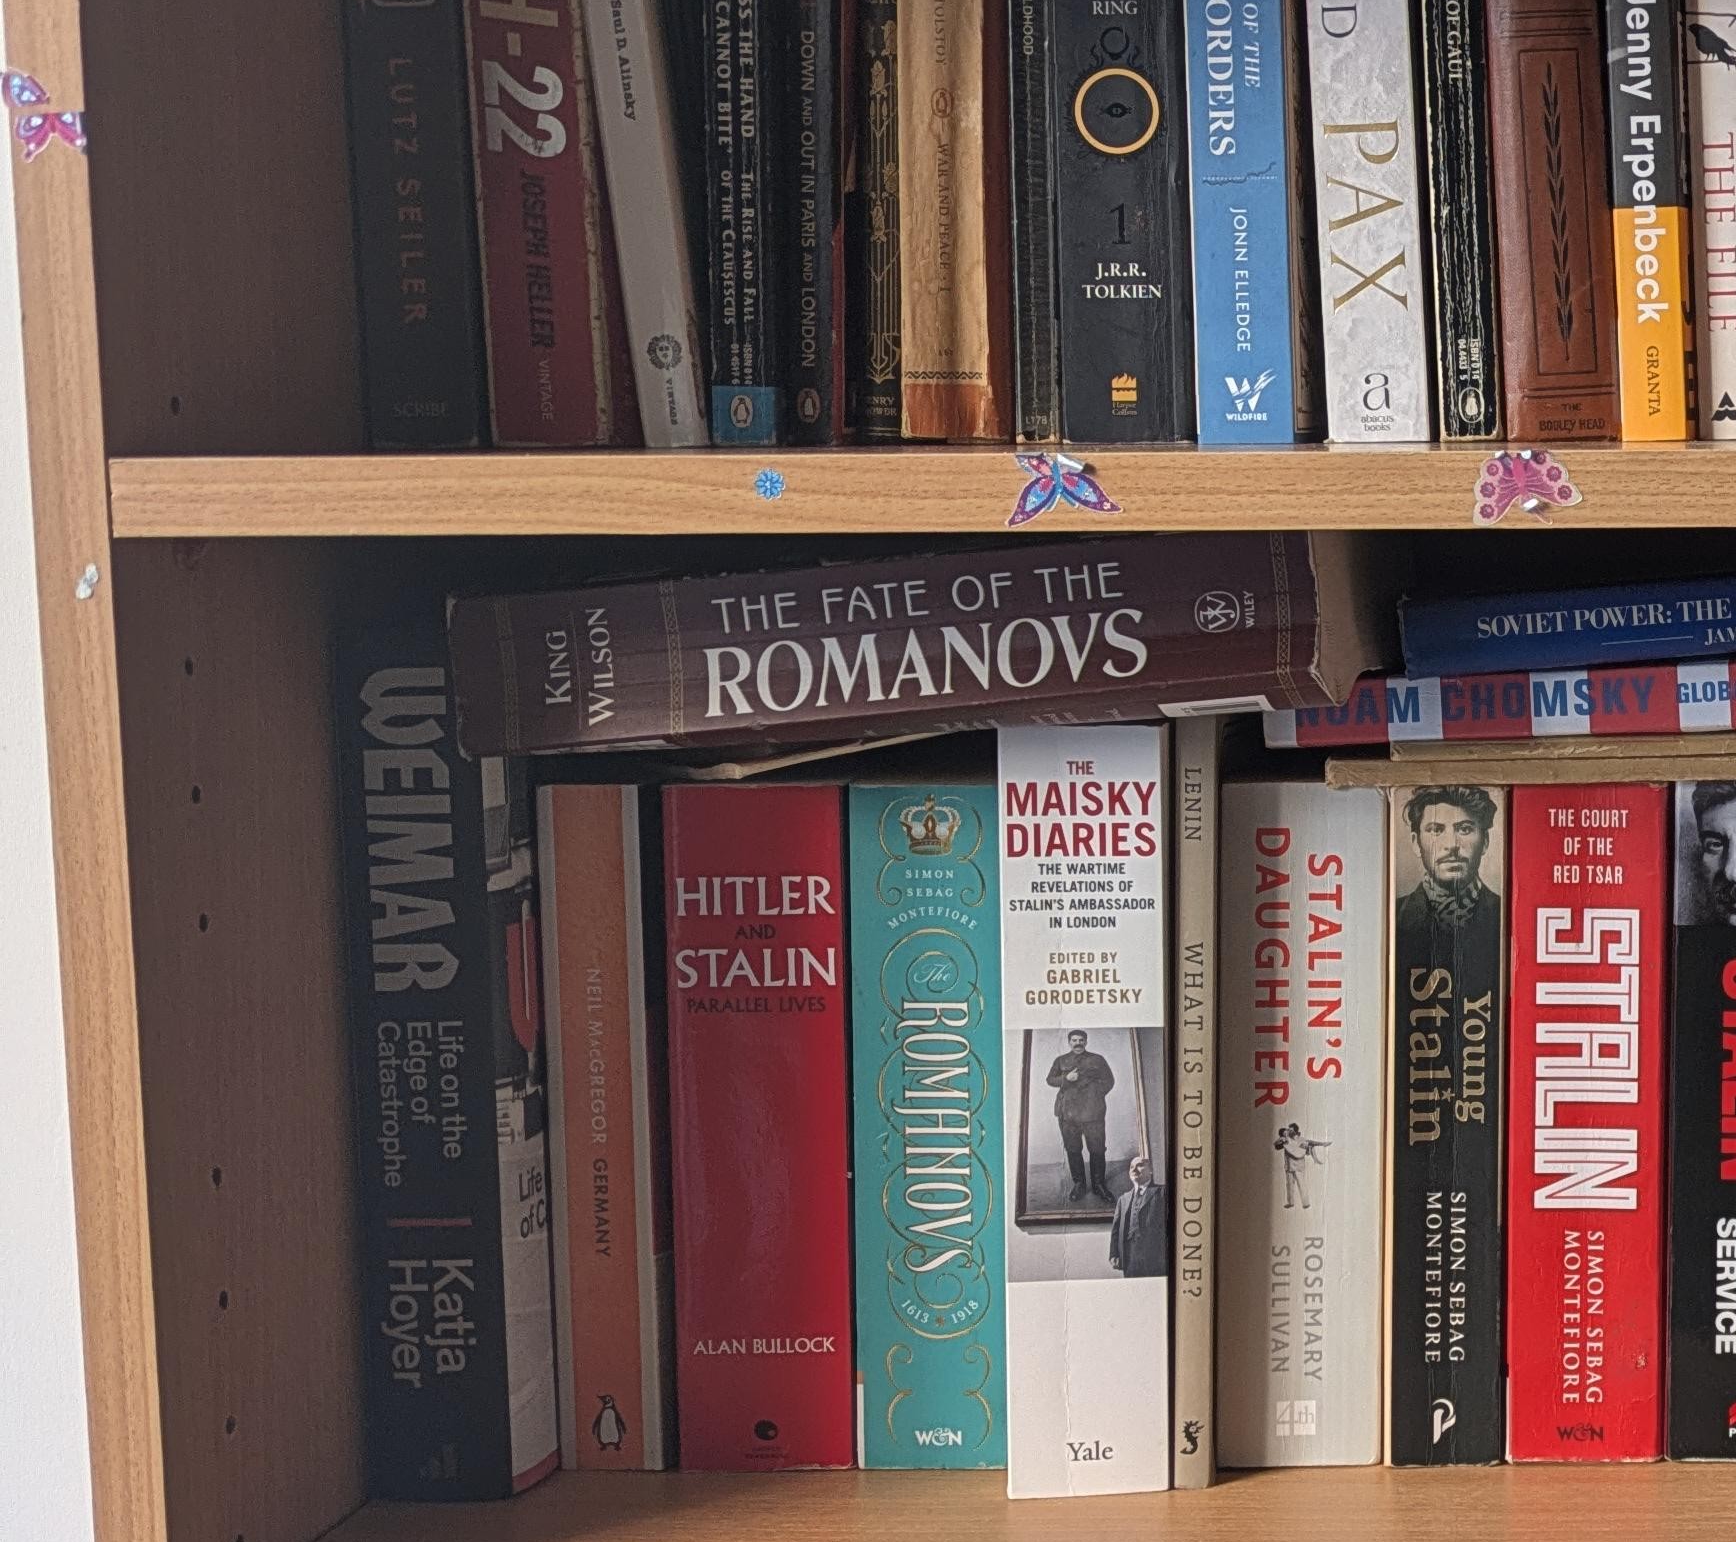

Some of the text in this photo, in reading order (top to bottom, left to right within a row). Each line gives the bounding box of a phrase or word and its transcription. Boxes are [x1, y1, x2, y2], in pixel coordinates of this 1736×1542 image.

[1091, 0, 1138, 16] RING
[1244, 4, 1260, 31] OF
[1243, 42, 1260, 88] THE
[1323, 119, 1408, 315] PAX
[1630, 114, 1663, 324] Erpenbeck
[1096, 262, 1147, 279] J.R.R.
[1082, 284, 1161, 299] TOLKIEN
[1645, 346, 1661, 417] GRANTA
[711, 562, 1121, 635] THE FATE OF THE
[1477, 611, 1568, 638] SOVIET
[1573, 603, 1672, 632] POWER:
[1680, 596, 1729, 622] THE
[705, 609, 1147, 718] ROMANOVS
[1067, 760, 1094, 776] THE
[1006, 782, 1155, 819] MAISKY
[1548, 809, 1628, 829] THE COURT
[1006, 823, 1157, 857] DIARIES
[1563, 836, 1613, 856] OF THE
[1038, 862, 1126, 875] THE WARTIME
[1553, 865, 1623, 884] RED TSAR
[675, 874, 836, 917] HITLER
[1032, 881, 1134, 893] REVELATIONS OF
[1009, 898, 1155, 912] STALIN'S AMBASSADOR
[734, 923, 776, 941] AND
[1050, 916, 1116, 928] IN LONDON
[675, 947, 837, 989] STALIN
[1049, 952, 1118, 965] EDITED BY
[1254, 827, 1290, 1109] DAUGHTER
[1307, 853, 1344, 1081] STALIN'S
[1047, 968, 1121, 985] GABRIEL
[687, 996, 826, 1015] PARALLEL LIVES
[1025, 989, 1143, 1005] GORODETSKY
[693, 1336, 836, 1355] ALAN BULLOCK
[1067, 1439, 1113, 1461] Yale
